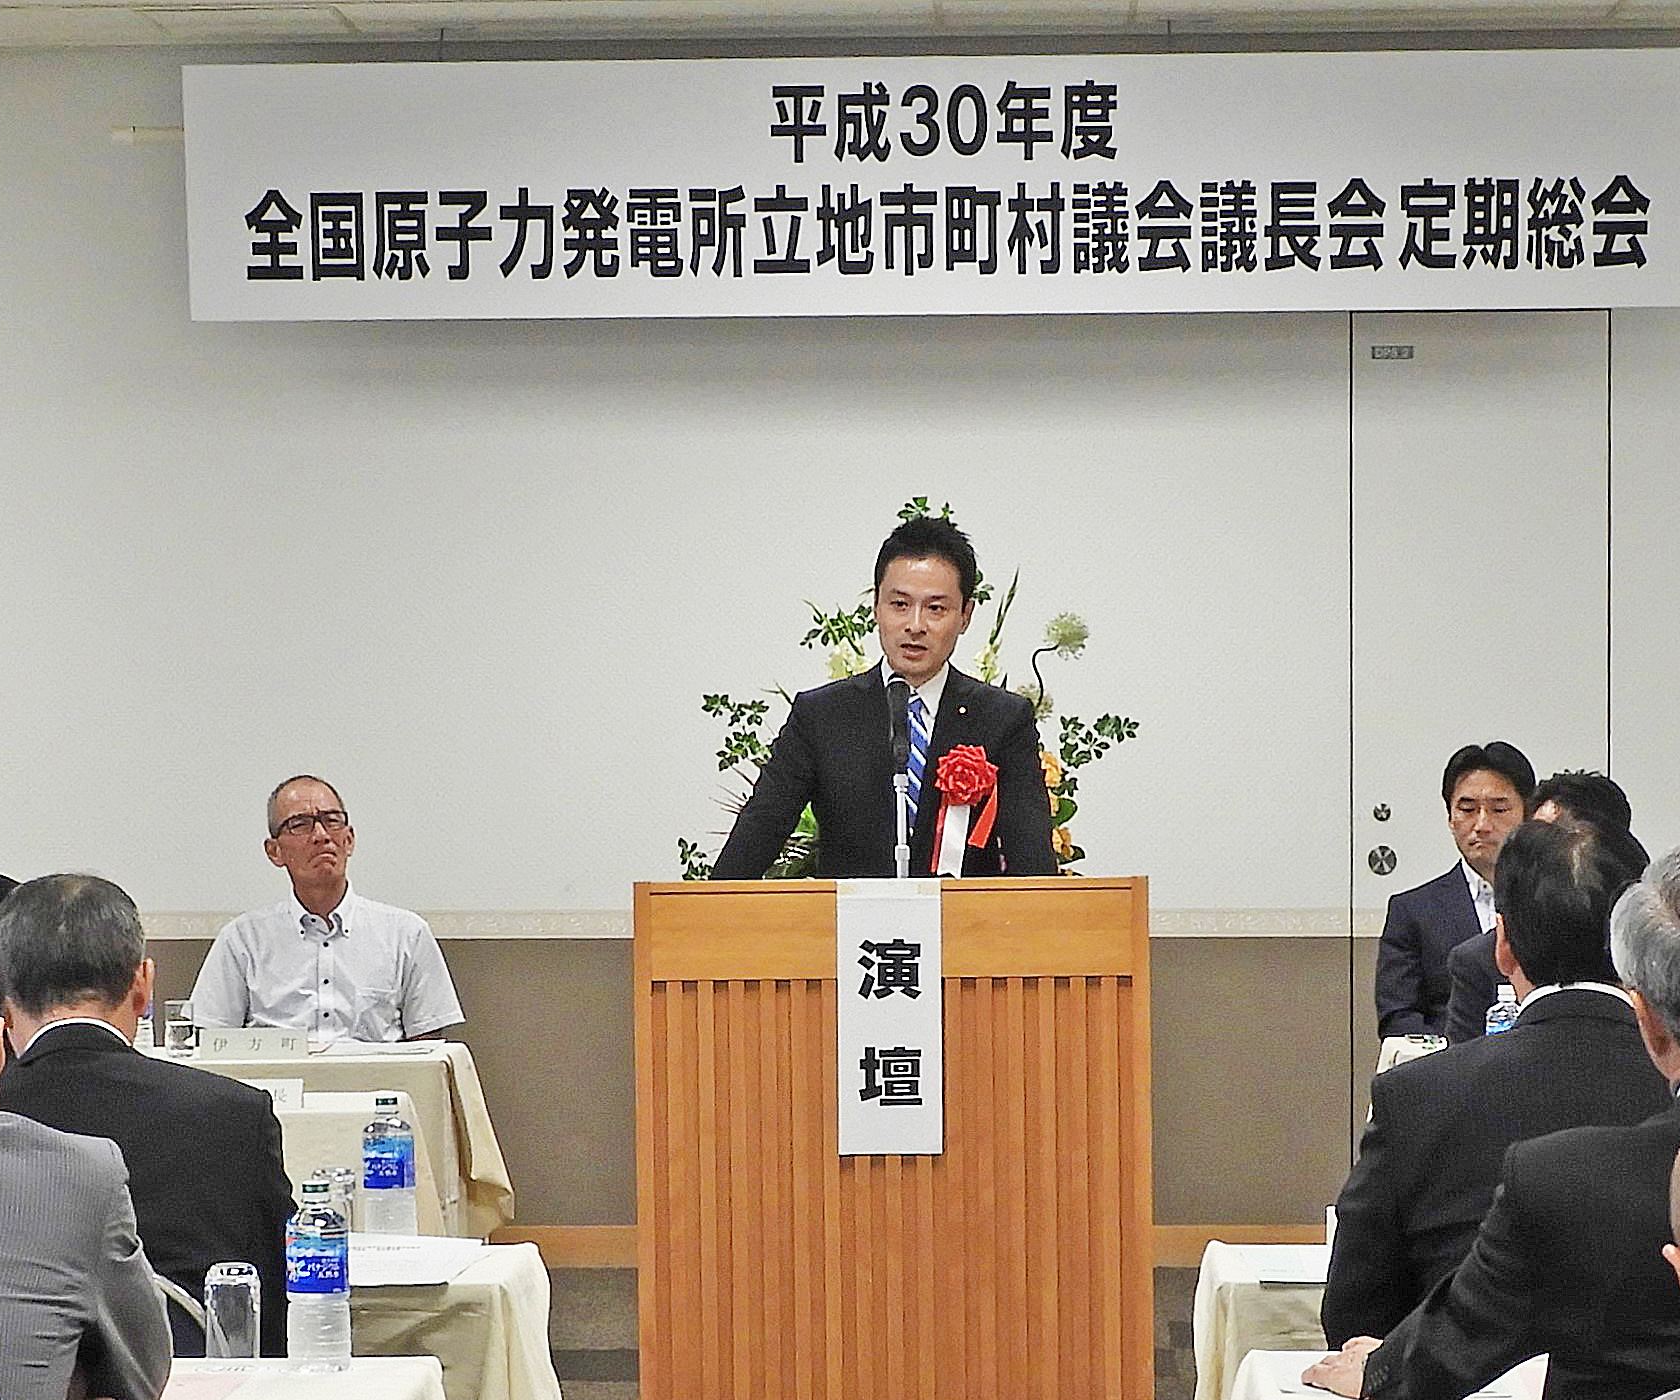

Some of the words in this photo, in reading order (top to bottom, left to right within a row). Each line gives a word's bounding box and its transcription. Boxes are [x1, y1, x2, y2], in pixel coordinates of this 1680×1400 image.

[771, 80, 1118, 164] 平成30年度
[244, 175, 1651, 282] 全国原子力発電所立地市町村議会議長会定期総会
[213, 1037, 297, 1052] 伊方町
[858, 939, 923, 1107] 演壇
